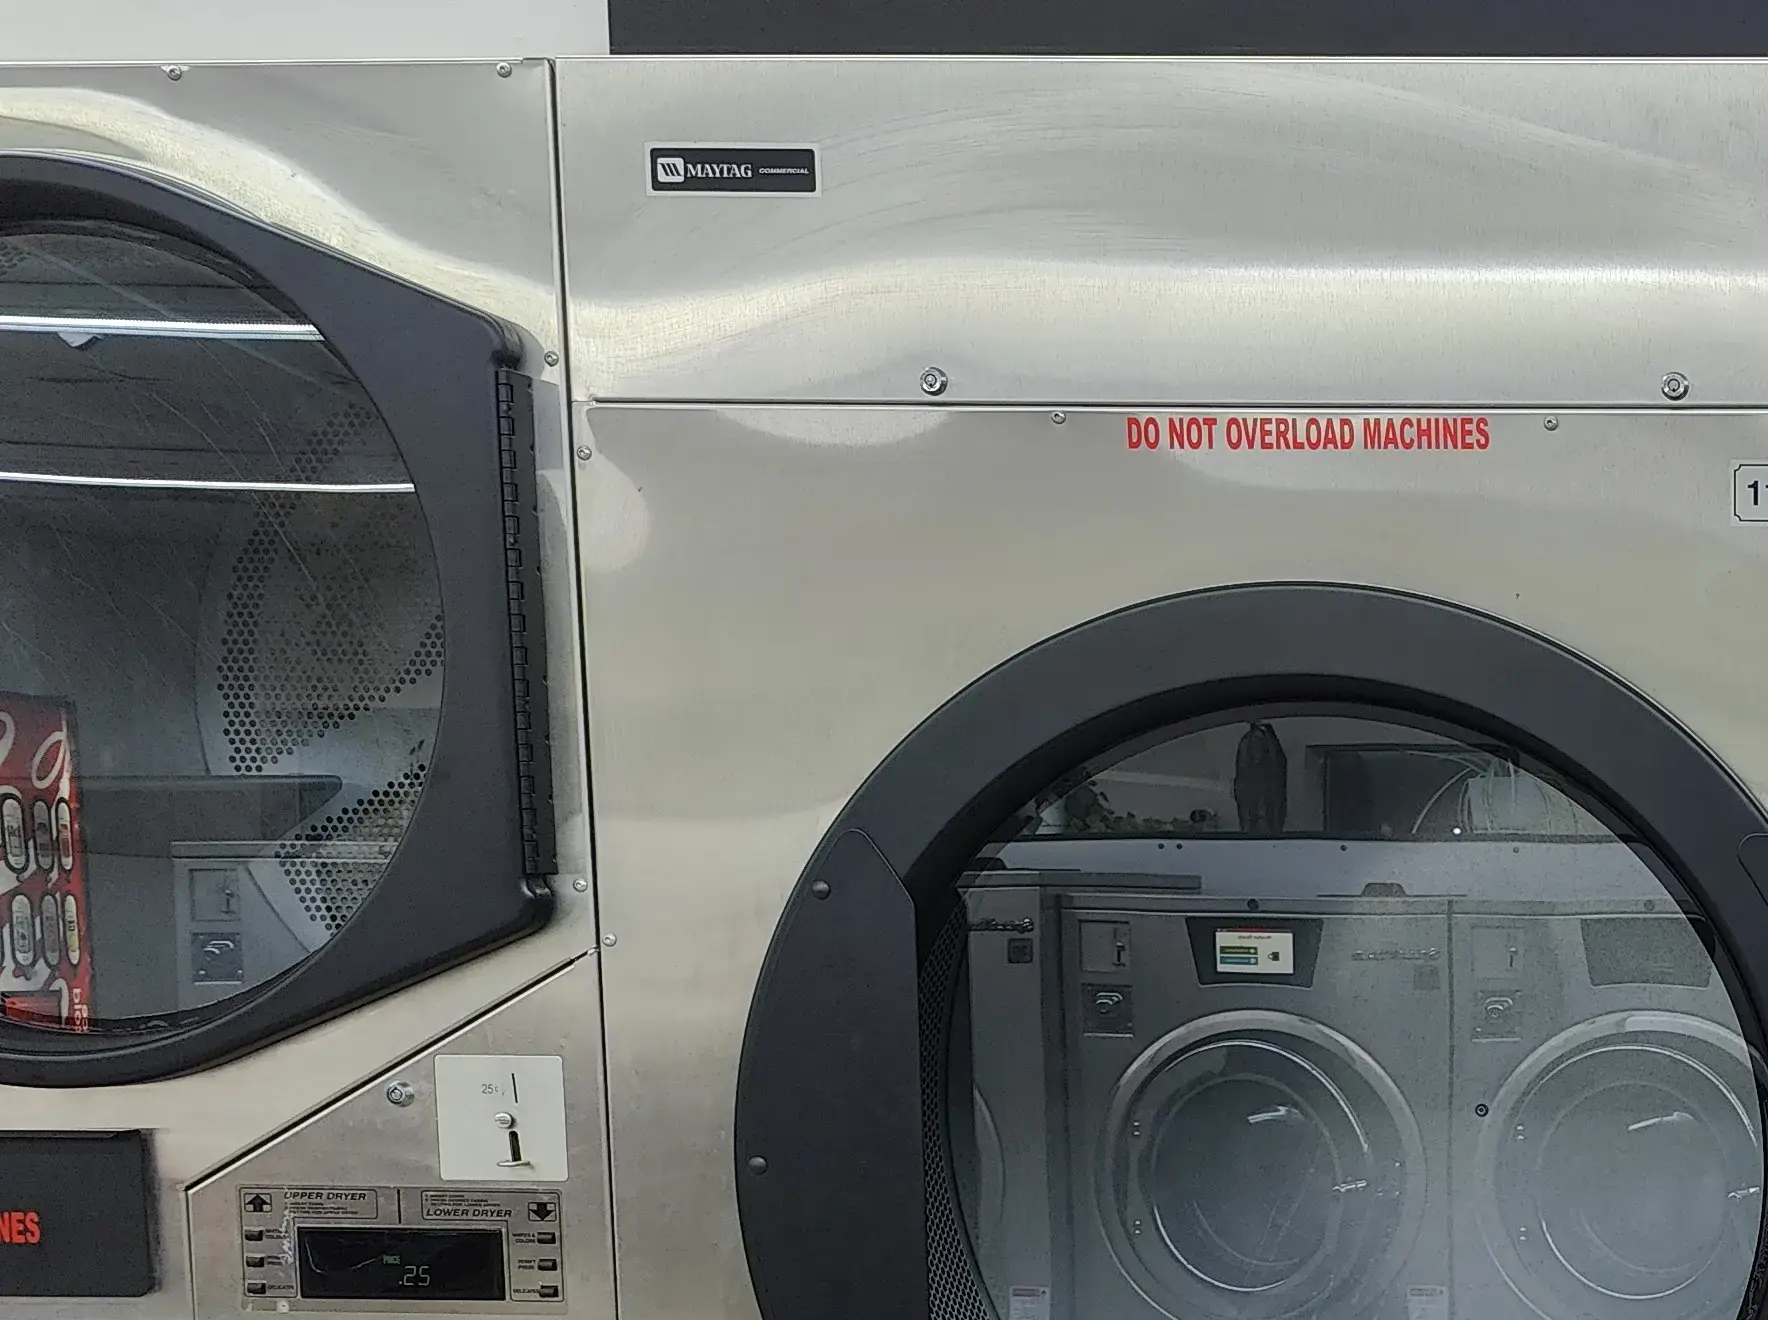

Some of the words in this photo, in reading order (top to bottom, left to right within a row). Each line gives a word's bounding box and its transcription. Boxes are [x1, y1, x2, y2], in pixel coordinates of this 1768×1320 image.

[686, 163, 752, 178] MAYTAG
[1126, 417, 1160, 450] DO
[1168, 417, 1217, 450] NOT
[1225, 417, 1354, 450] OVERLOAD
[1362, 417, 1490, 450] MACHINES
[284, 1191, 324, 1200] UPPER
[326, 1192, 366, 1200] DRYER
[426, 1208, 469, 1217] LOWER
[472, 1209, 512, 1217] DRYER
